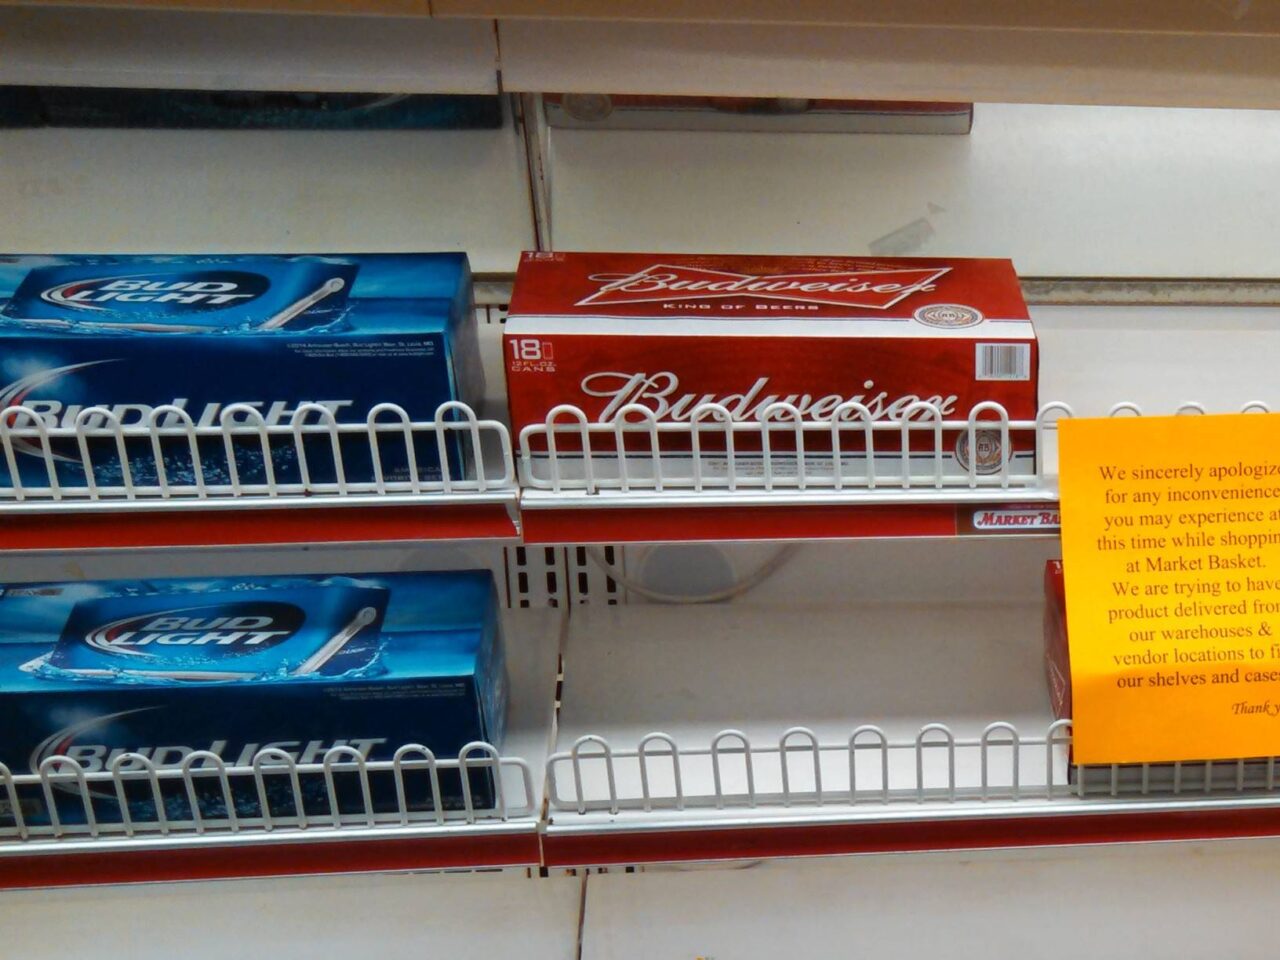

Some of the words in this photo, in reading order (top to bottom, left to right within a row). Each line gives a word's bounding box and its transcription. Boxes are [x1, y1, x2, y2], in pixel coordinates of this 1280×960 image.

[99, 280, 239, 293] BUD
[588, 268, 936, 298] Budweiser
[74, 290, 255, 304] LIGHT
[722, 302, 746, 310] OF
[756, 302, 819, 311] BEERS
[509, 338, 541, 360] 18
[582, 371, 957, 424] Budweiser
[12, 400, 154, 429] BUD
[160, 398, 354, 428] LIGHT
[1099, 464, 1127, 481] We
[1132, 462, 1204, 481] sincerely
[1105, 489, 1129, 504] for
[1133, 491, 1161, 505] any
[1167, 485, 1280, 502] inconvenience
[1104, 515, 1133, 531] you
[1140, 515, 1172, 530] may
[1179, 509, 1264, 528] experience
[1097, 535, 1126, 551] this
[1131, 533, 1166, 549] time
[1172, 531, 1215, 548] while
[1126, 559, 1140, 573] at
[1146, 556, 1203, 572] Market
[1208, 553, 1267, 570] Basket.
[1112, 581, 1139, 596] We
[1145, 582, 1169, 595] are
[1175, 577, 1221, 597] trying
[1227, 578, 1241, 592] to
[1108, 603, 1169, 623] product
[1174, 598, 1248, 618] delivered
[141, 616, 273, 631] BUD
[1129, 630, 1155, 643] our
[1161, 623, 1253, 641] warehouses
[1258, 621, 1273, 637] &
[115, 629, 291, 646] LIGHT
[1113, 650, 1169, 666] vendor
[1174, 647, 1245, 664] locations
[1250, 646, 1265, 659] to
[1117, 675, 1144, 689] our
[1149, 670, 1206, 687] shelves
[1211, 669, 1240, 684] and
[1232, 701, 1271, 716] Thank
[57, 745, 193, 773] BUD
[202, 738, 388, 769] LIGHT
